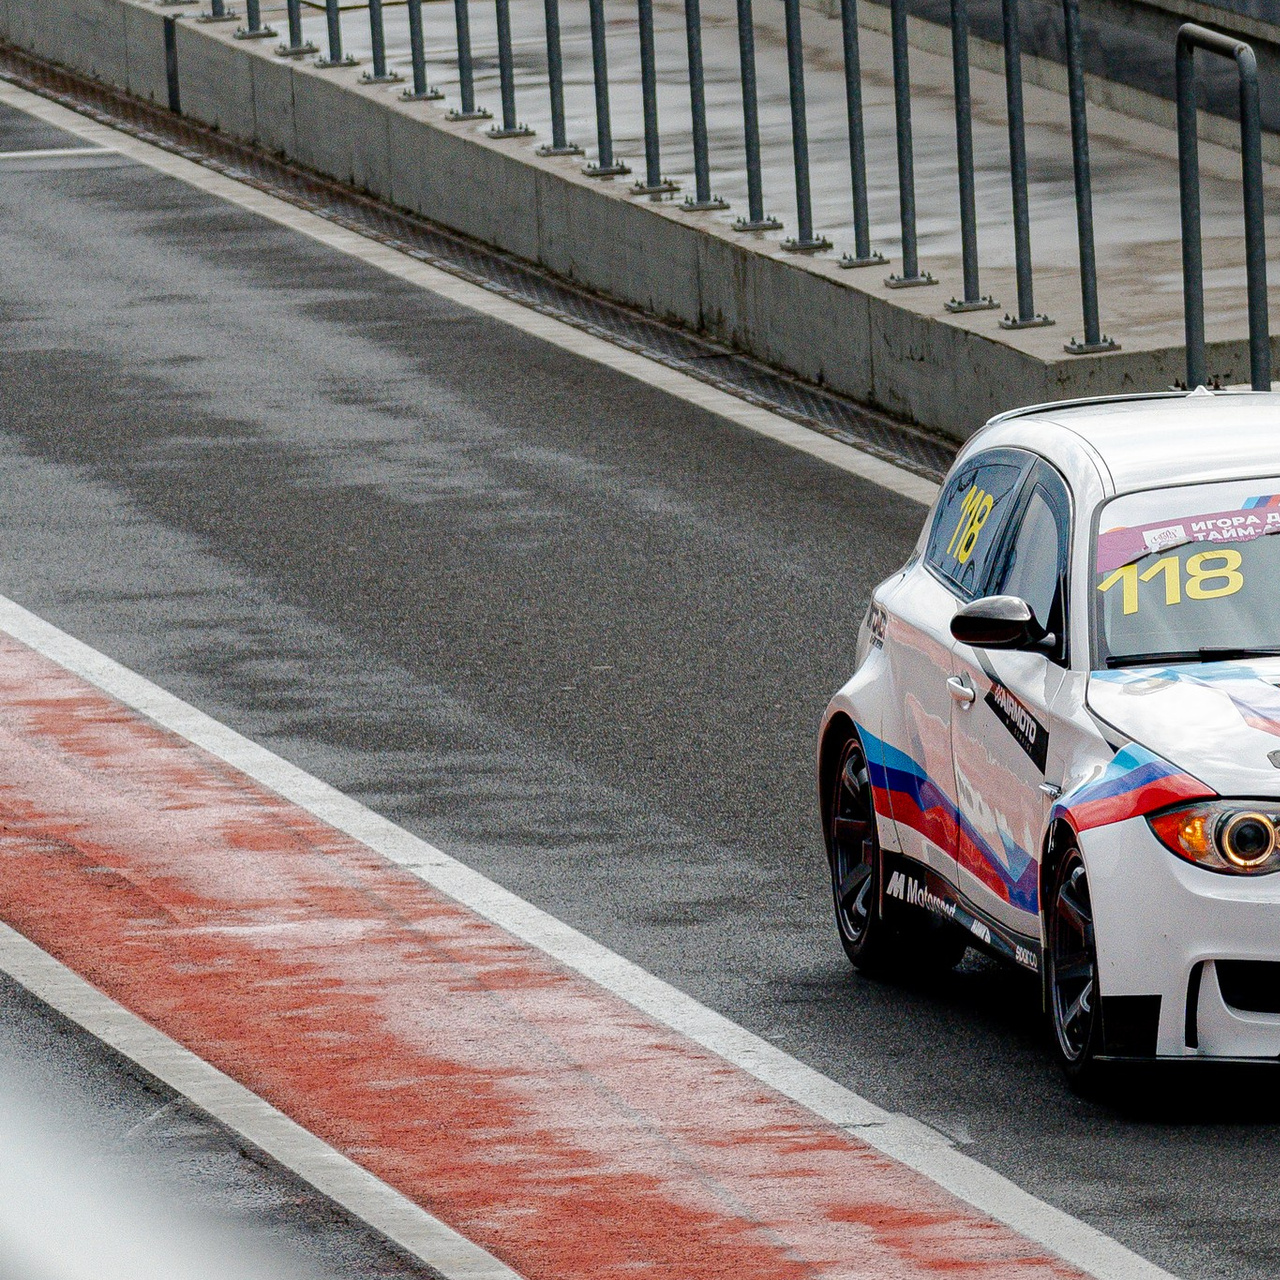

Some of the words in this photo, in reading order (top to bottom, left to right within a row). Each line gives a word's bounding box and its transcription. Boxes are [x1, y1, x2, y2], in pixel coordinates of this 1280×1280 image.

[946, 485, 994, 564] 118
[1191, 515, 1260, 531] ИГОРА
[1097, 549, 1244, 616] 118
[906, 876, 956, 917] Motorsport
[1015, 943, 1038, 969] sparco
